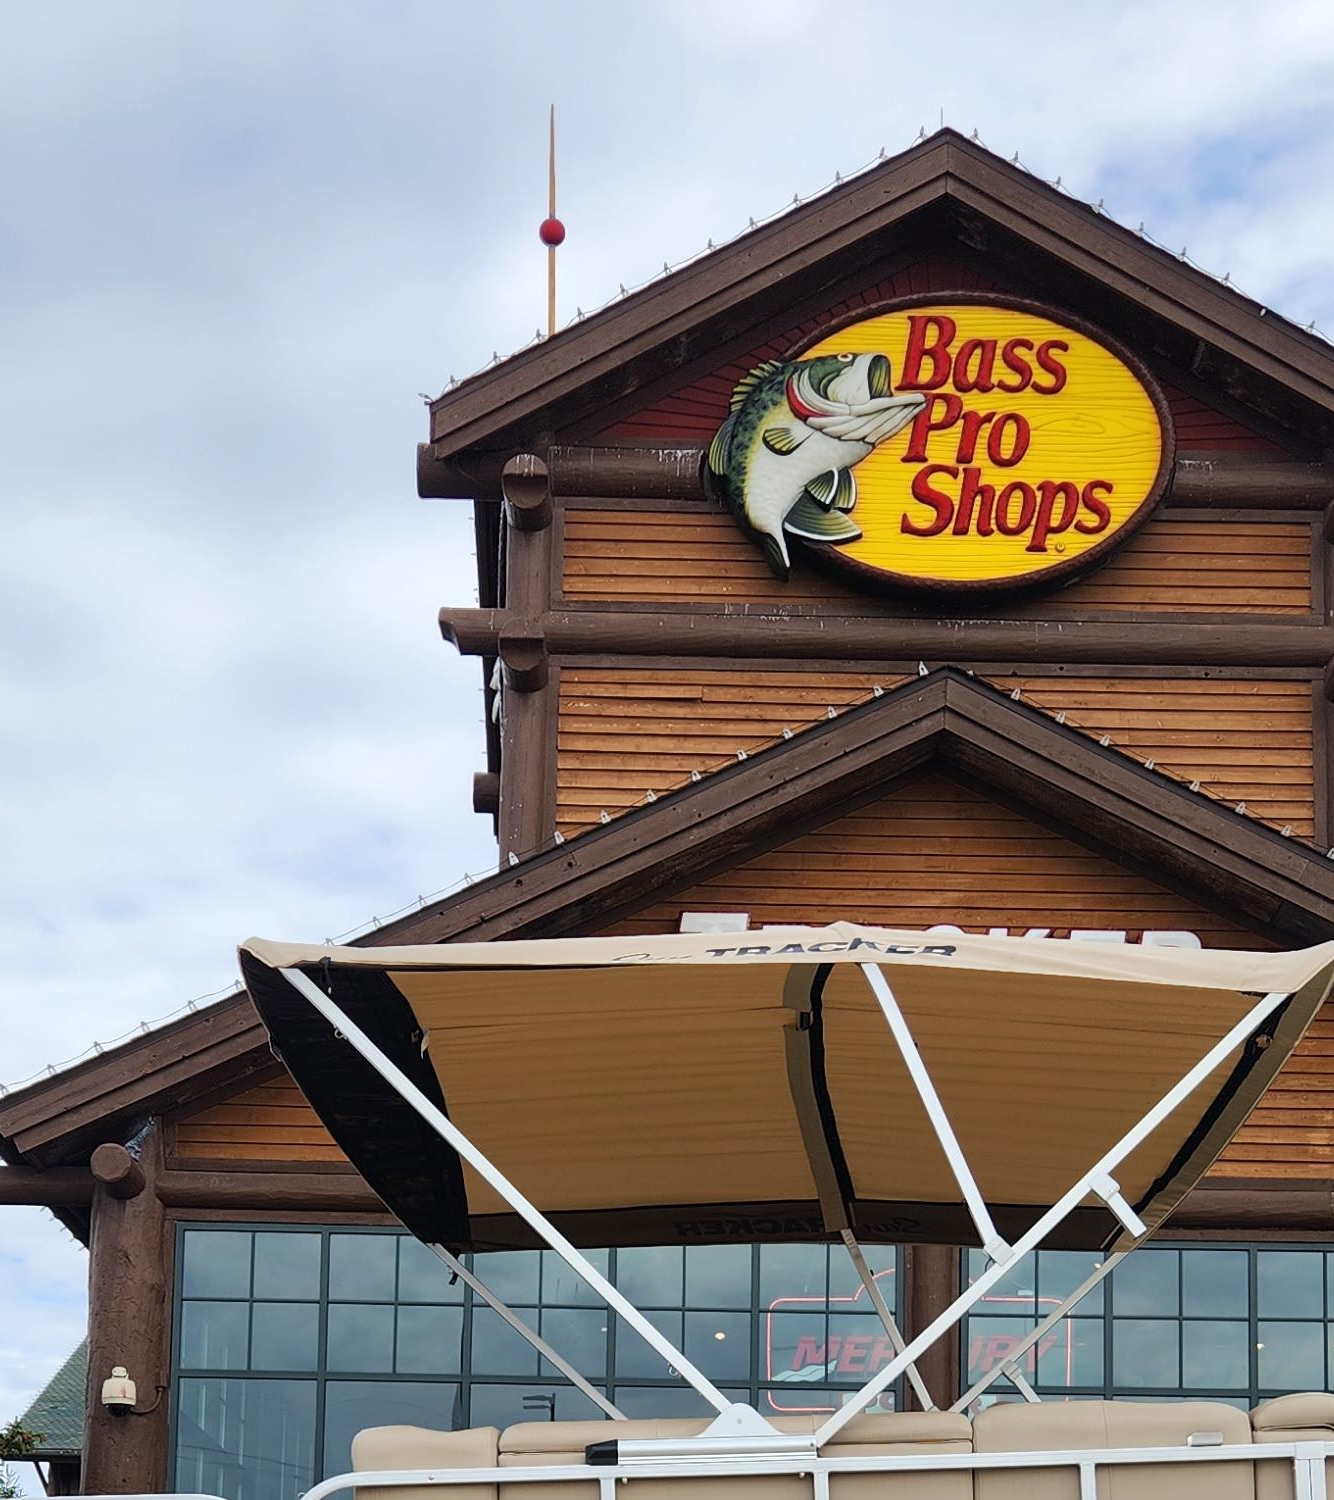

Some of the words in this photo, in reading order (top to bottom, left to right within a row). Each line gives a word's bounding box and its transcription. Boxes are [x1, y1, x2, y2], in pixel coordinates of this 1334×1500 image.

[894, 314, 1070, 395] Bass
[900, 391, 1031, 468] Pro
[900, 463, 1114, 553] Shops
